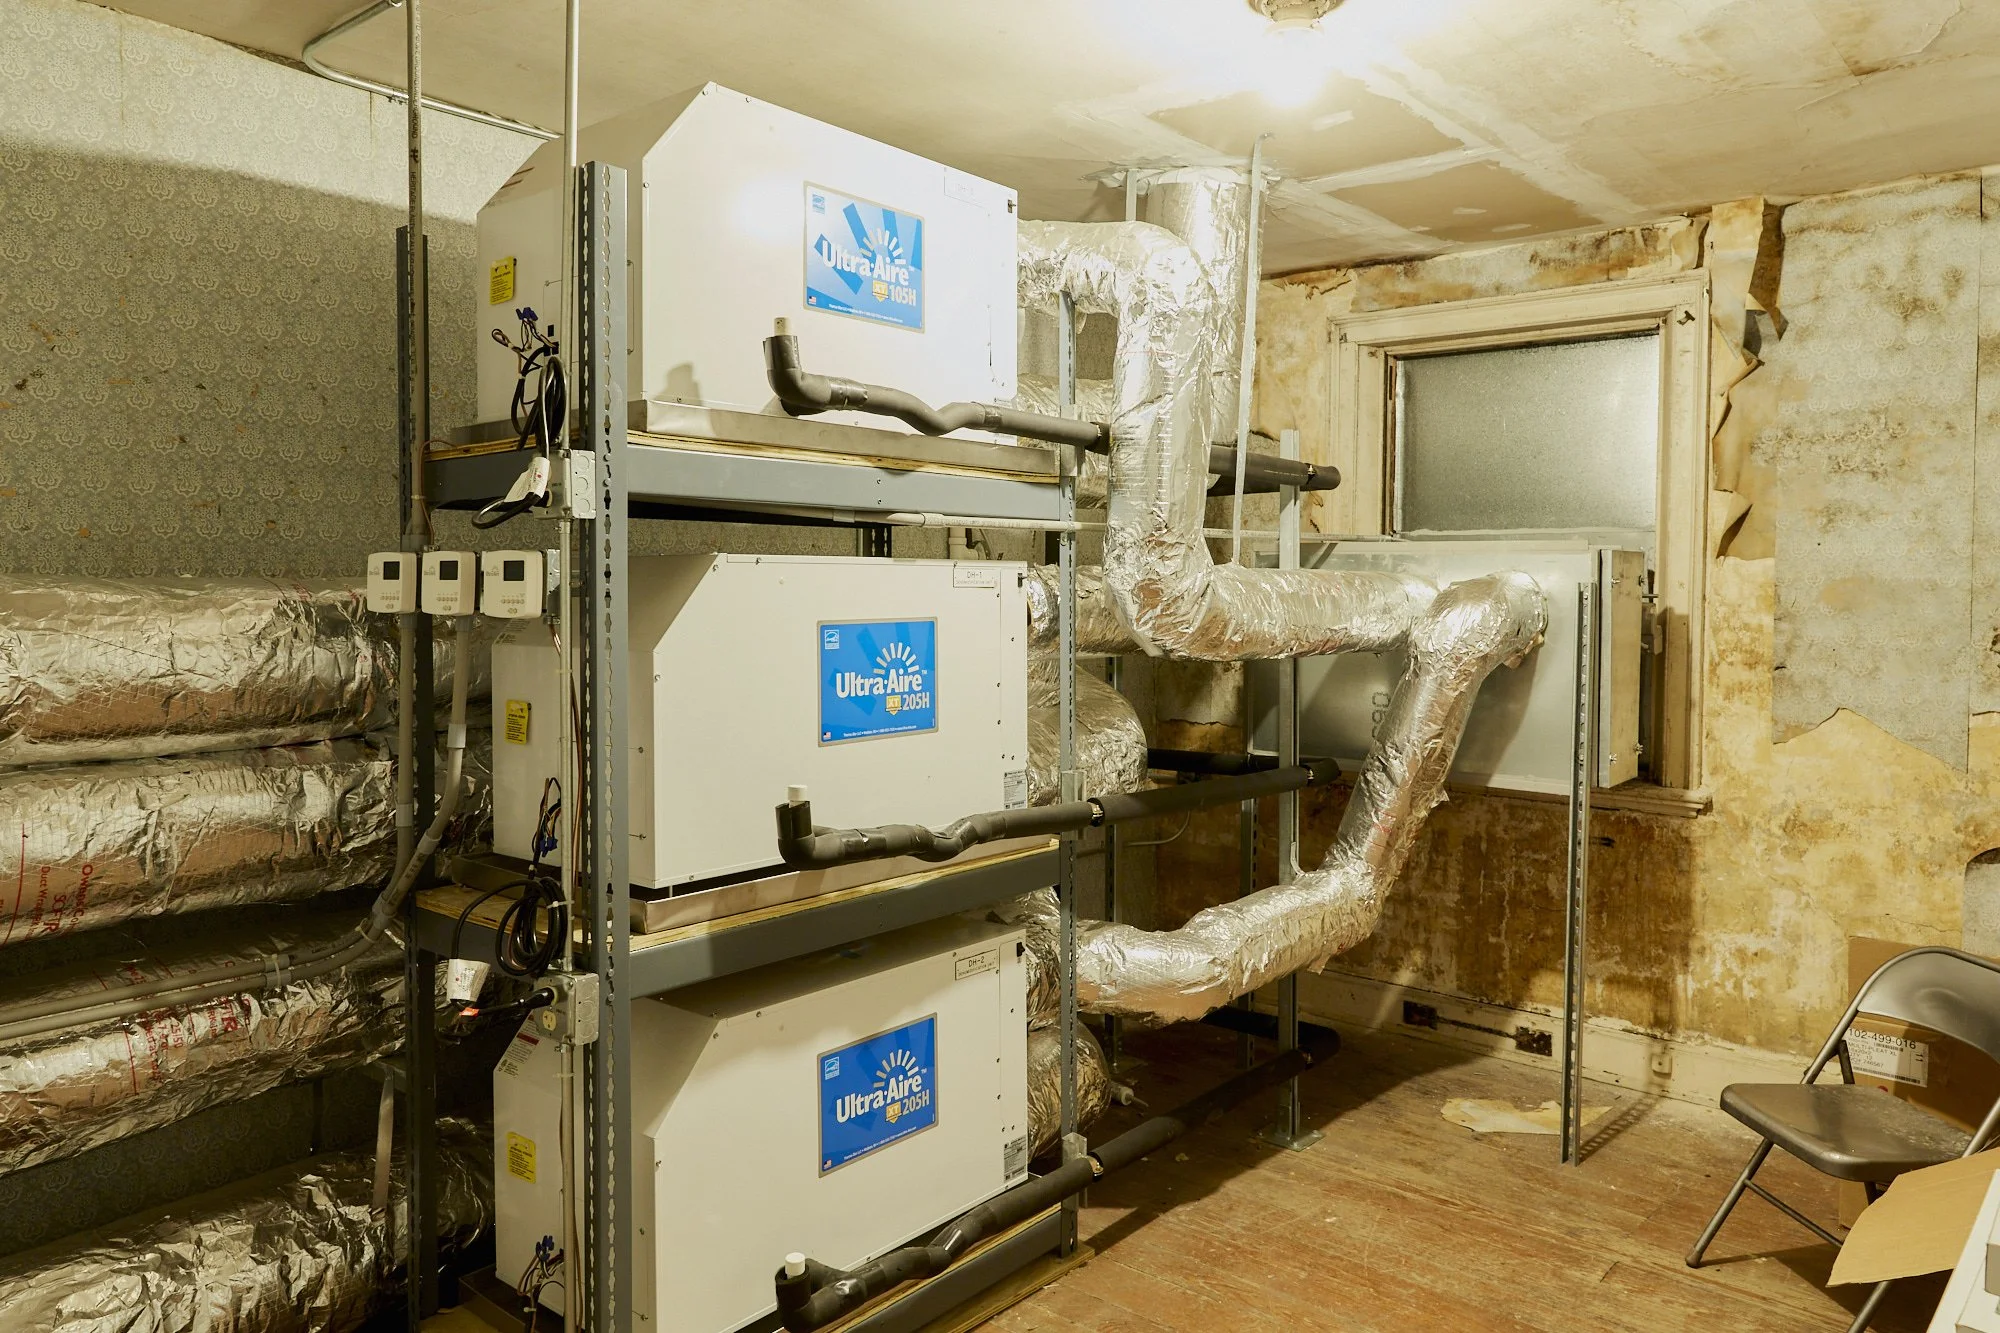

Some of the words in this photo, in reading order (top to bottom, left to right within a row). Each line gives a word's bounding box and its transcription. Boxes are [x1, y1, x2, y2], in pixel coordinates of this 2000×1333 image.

[889, 284, 917, 307] 105H
[888, 697, 900, 708] XT
[902, 692, 930, 711] 205H
[40, 866, 51, 887] Duct
[968, 955, 985, 968] DH-2
[1849, 1028, 1917, 1050] 102-499-016
[888, 1105, 900, 1116] XT
[902, 1089, 930, 1116] 205H
